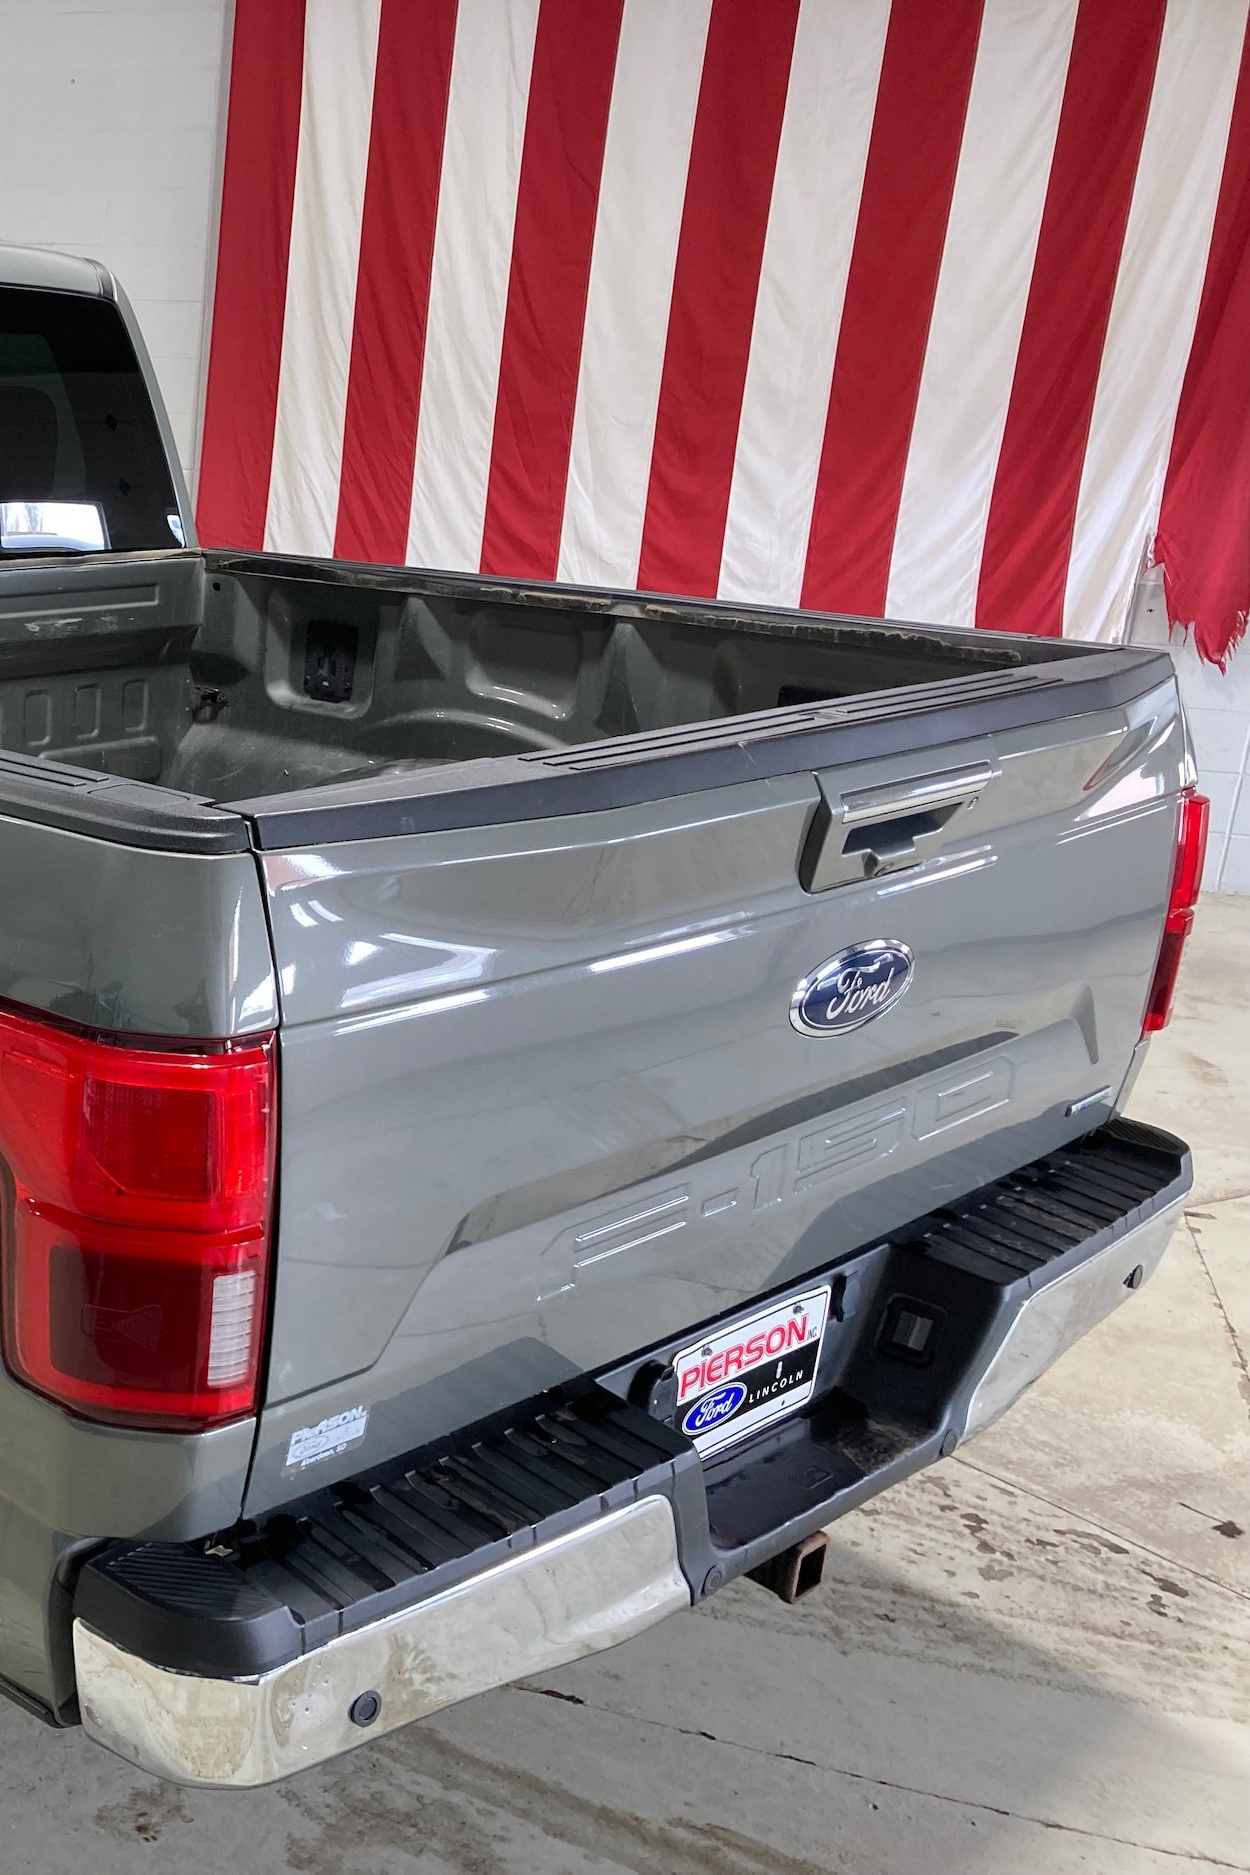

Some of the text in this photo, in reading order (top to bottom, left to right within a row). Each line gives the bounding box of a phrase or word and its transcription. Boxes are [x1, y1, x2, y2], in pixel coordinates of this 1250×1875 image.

[825, 961, 895, 1021] Ford
[535, 1055, 1017, 1302] F-150
[679, 1313, 809, 1401] PIERSON
[748, 1369, 805, 1404] LINCOLN
[694, 1390, 736, 1428] Ford
